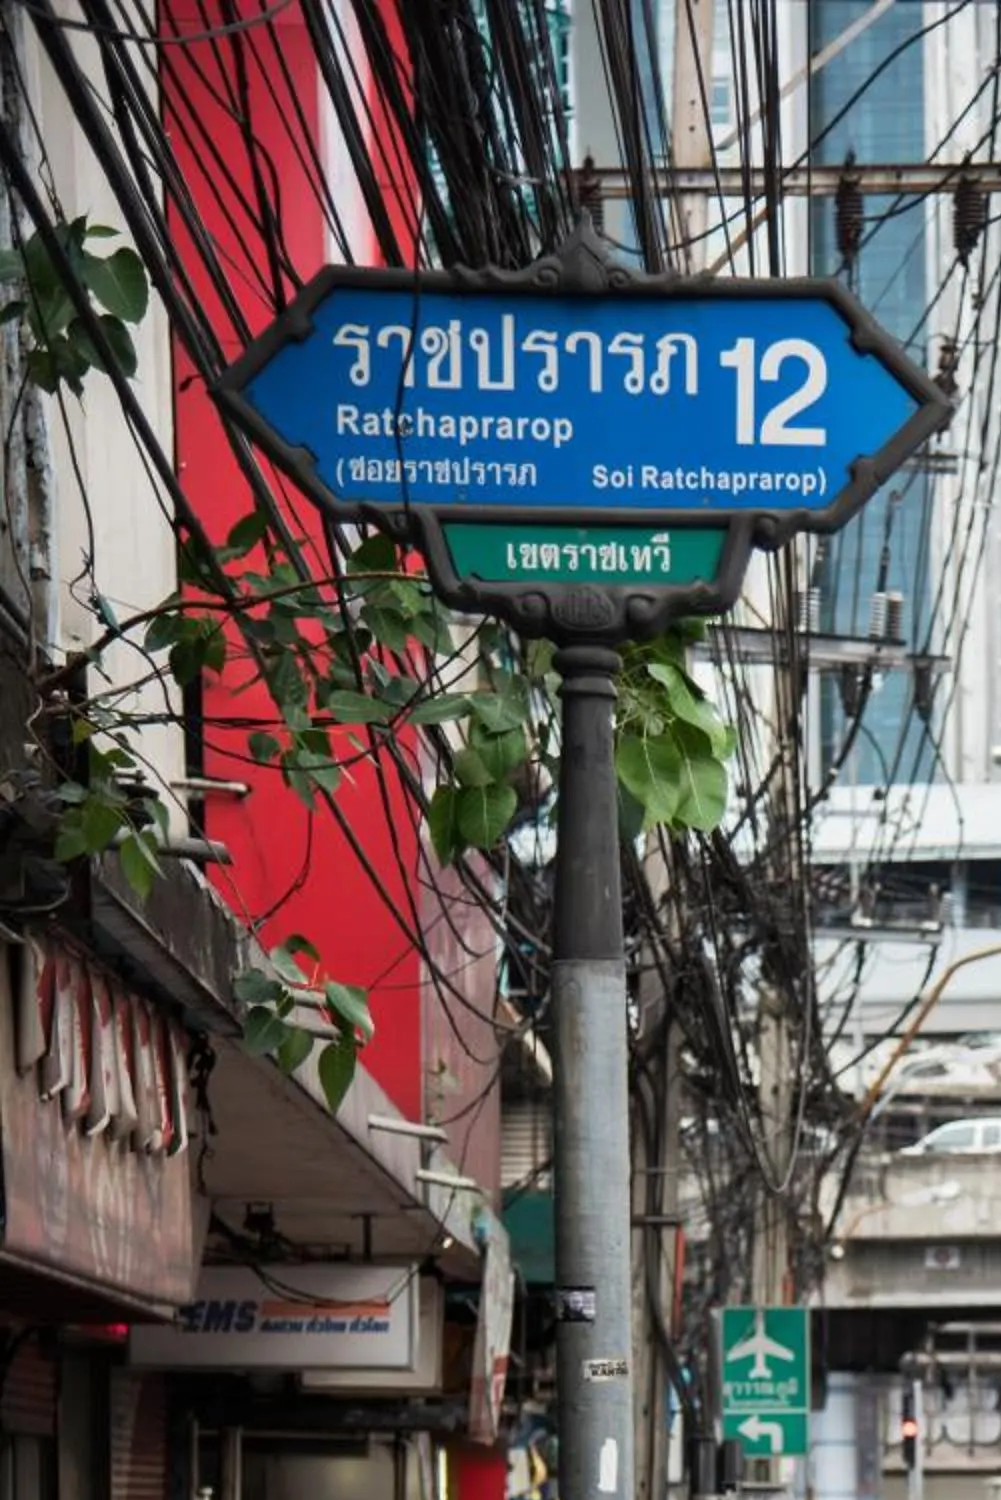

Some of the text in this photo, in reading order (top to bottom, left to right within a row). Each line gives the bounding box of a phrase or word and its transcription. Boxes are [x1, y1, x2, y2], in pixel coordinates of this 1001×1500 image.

[333, 313, 827, 446] ราชปรารภ 12
[336, 403, 574, 448] Ratchaprarop
[592, 465, 827, 496] Soi Ratchaprarop)
[506, 532, 671, 573] เขตราชเทวี
[179, 1301, 258, 1334] EMS
